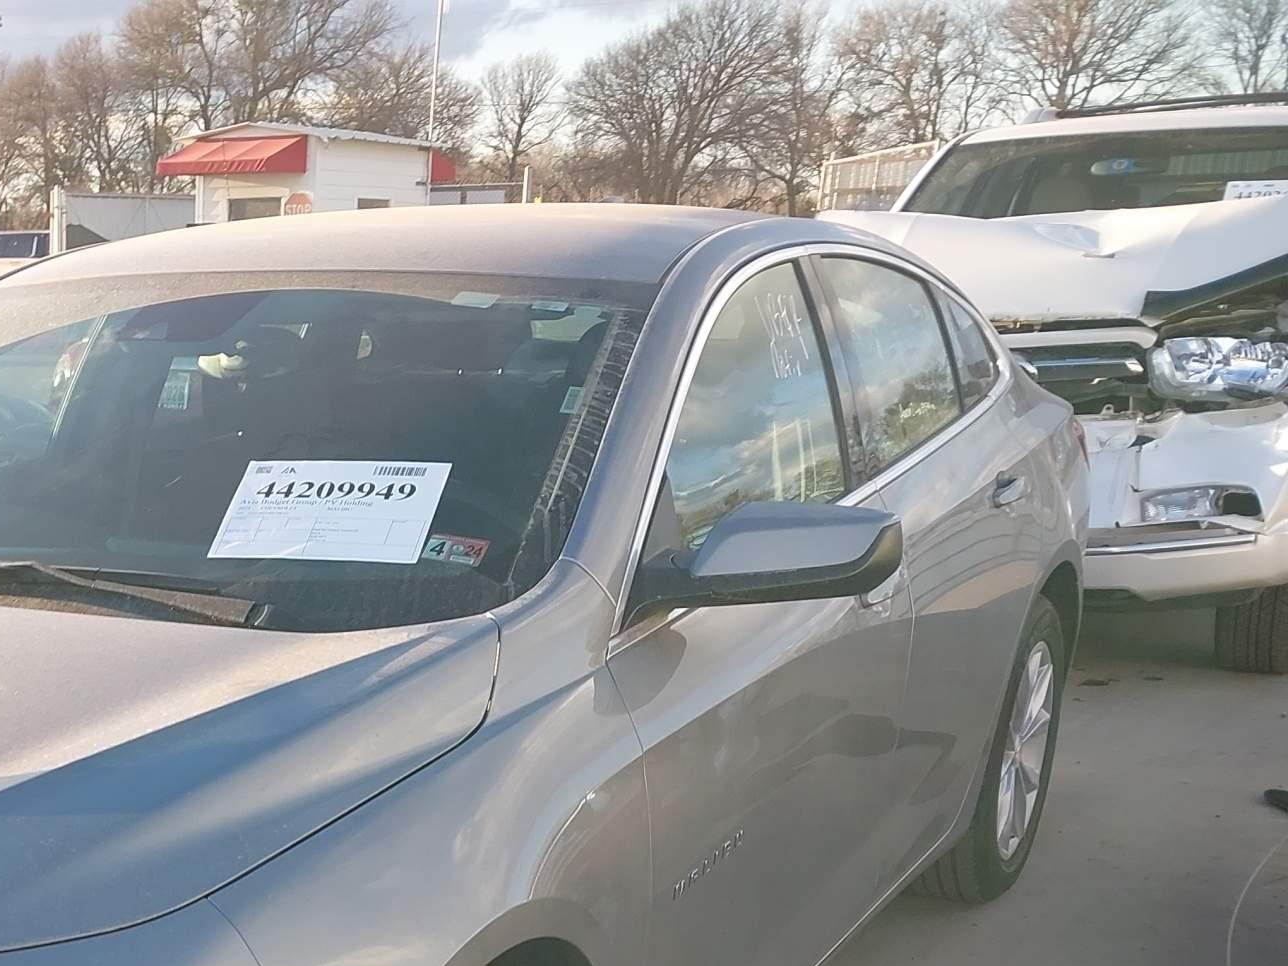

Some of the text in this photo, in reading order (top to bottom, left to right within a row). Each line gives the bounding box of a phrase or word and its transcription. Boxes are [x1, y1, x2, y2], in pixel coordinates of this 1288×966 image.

[285, 203, 312, 216] STOP
[256, 480, 418, 501] 44209949
[429, 541, 447, 556] 4
[465, 544, 484, 558] 24
